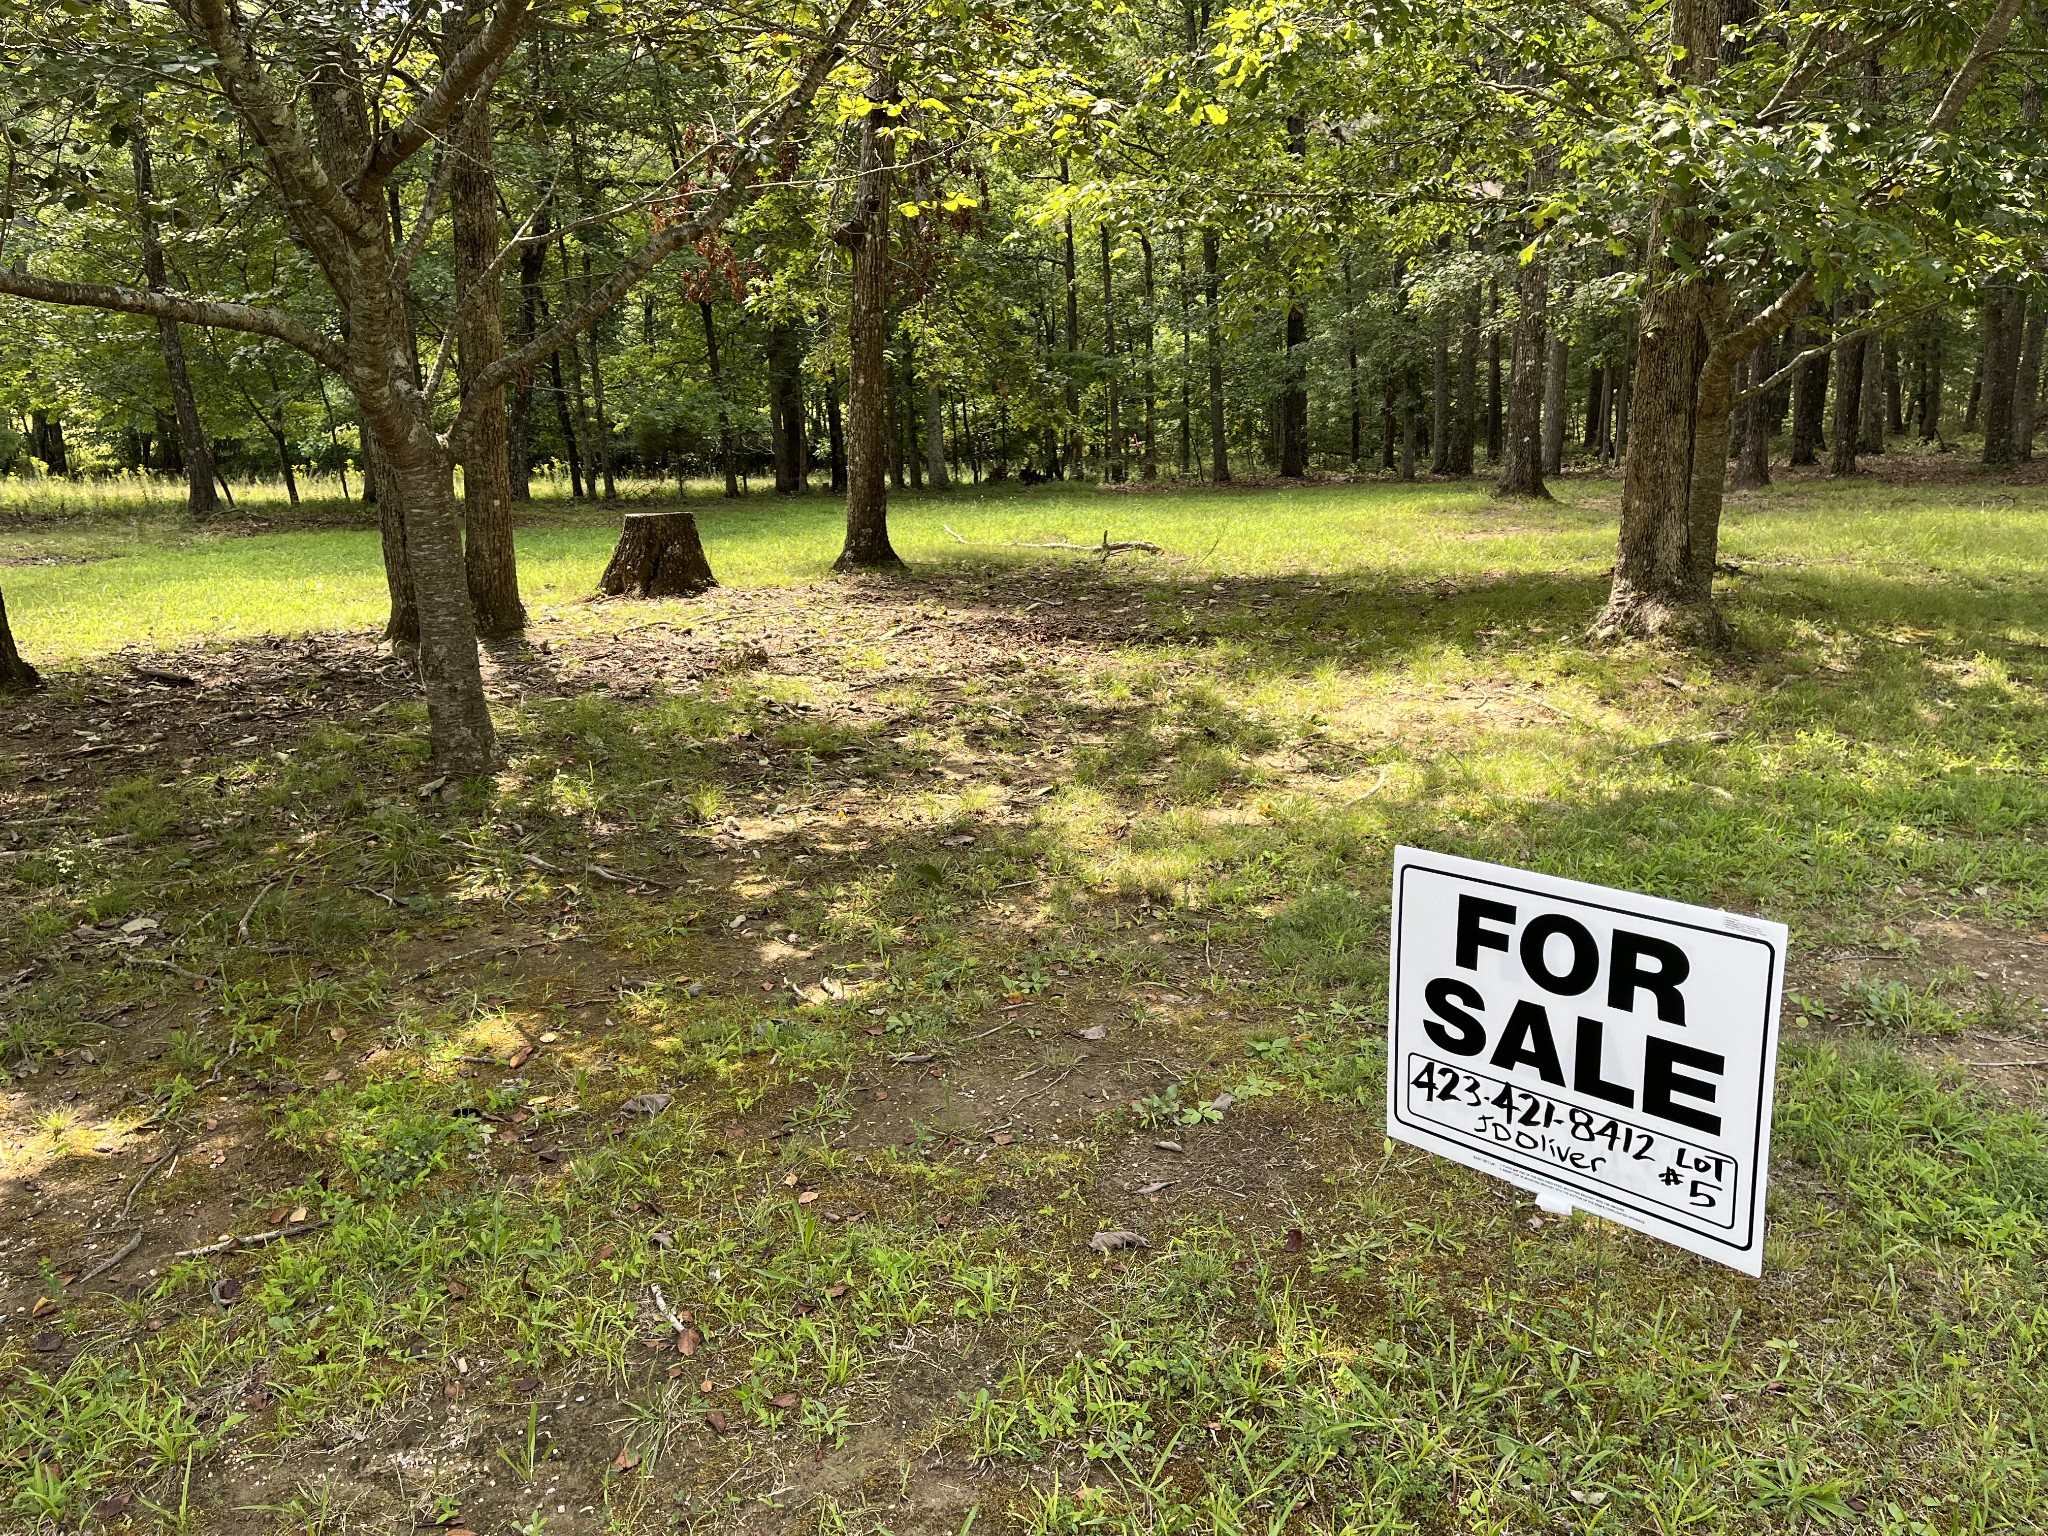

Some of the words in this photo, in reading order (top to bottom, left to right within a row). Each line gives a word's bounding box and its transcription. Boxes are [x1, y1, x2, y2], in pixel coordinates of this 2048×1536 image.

[1456, 893, 1690, 1028] FOR
[1410, 1061, 1656, 1162] 423-421-8412
[1422, 977, 1725, 1137] SALE
